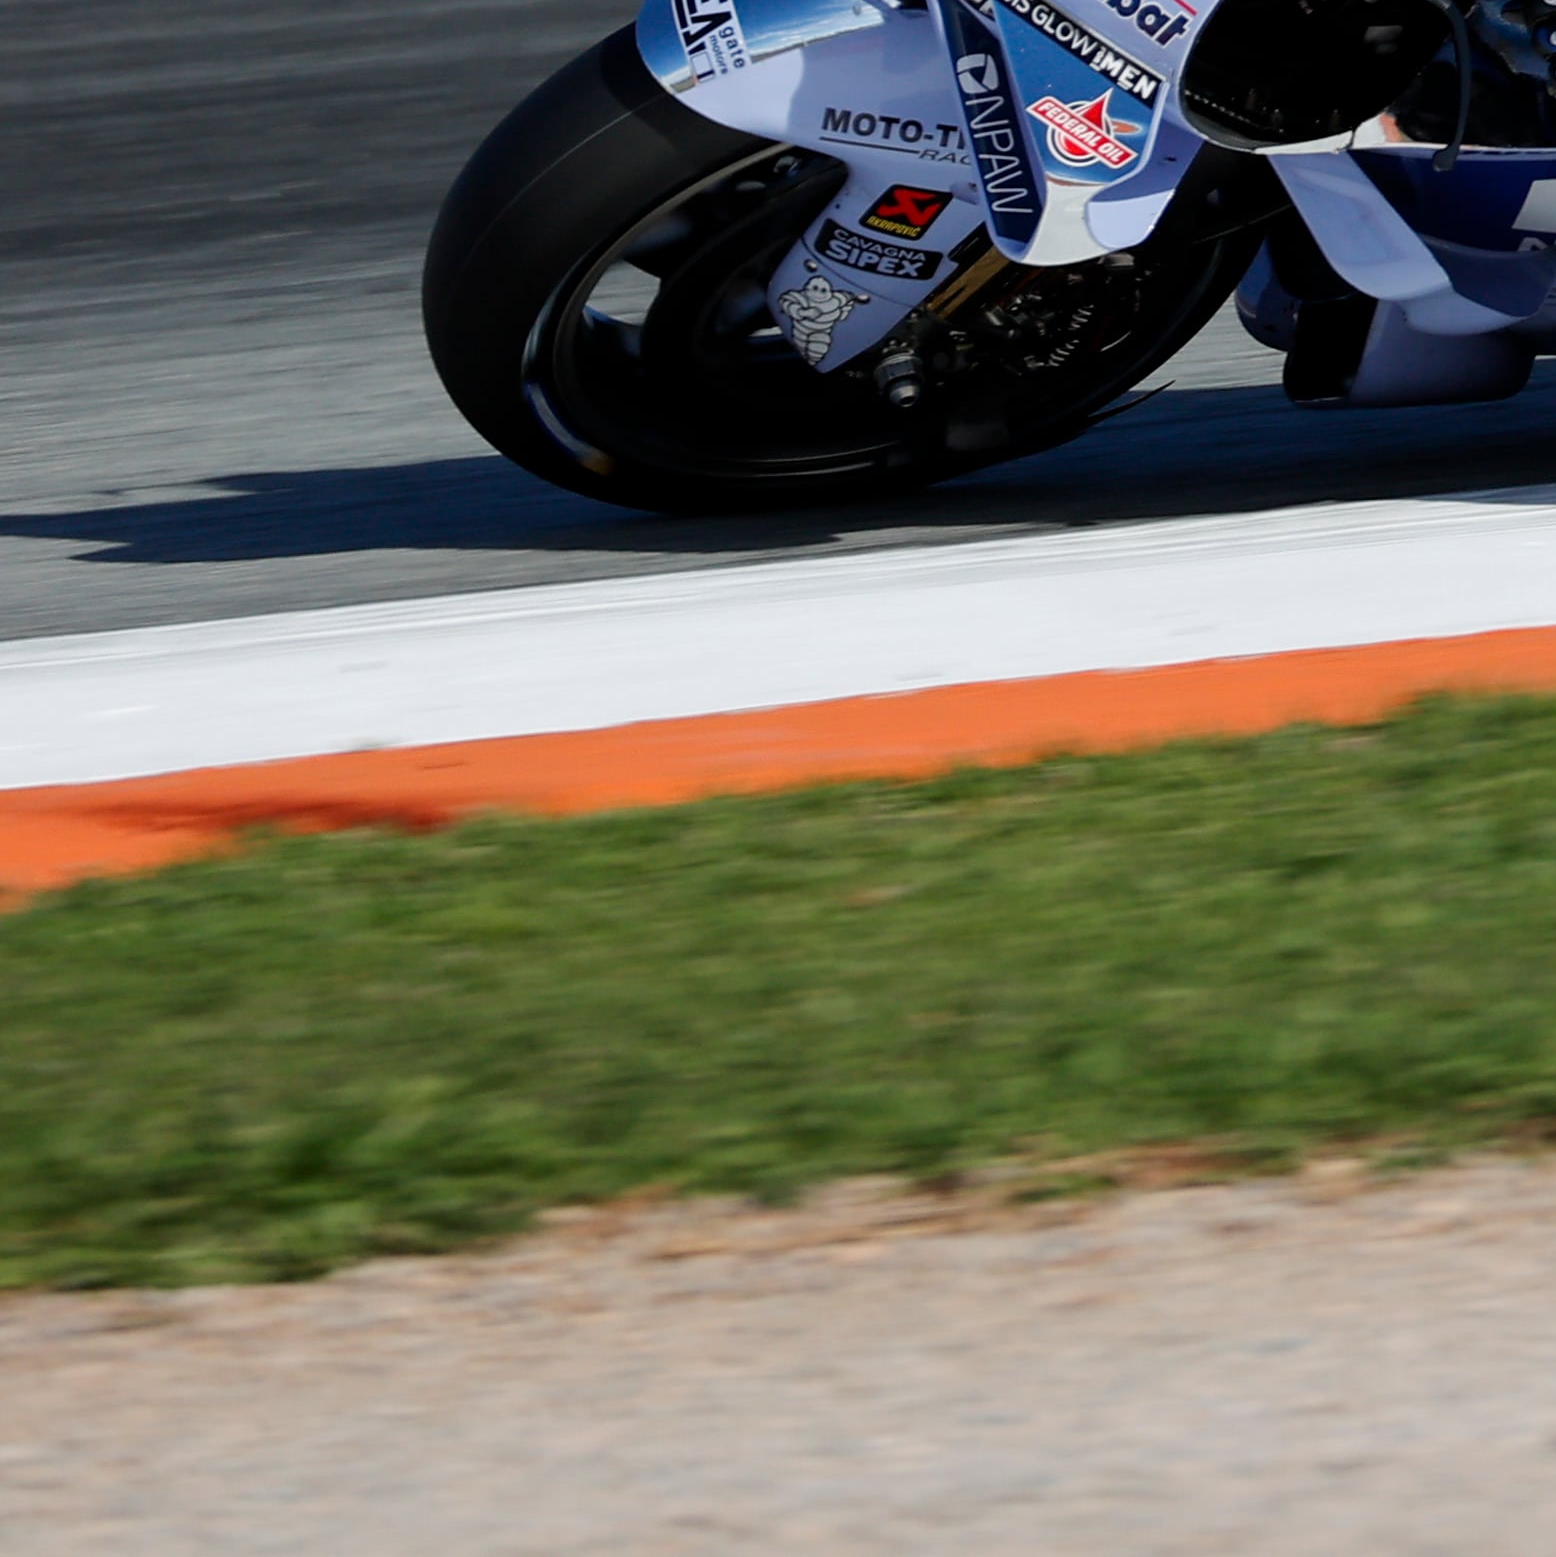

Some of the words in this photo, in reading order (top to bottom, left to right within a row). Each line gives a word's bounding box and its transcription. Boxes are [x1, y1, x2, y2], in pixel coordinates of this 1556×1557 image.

[718, 26, 746, 69] gate
[1031, 3, 1099, 57] GLOW
[708, 33, 730, 76] motors
[1037, 100, 1099, 147] FEDERAL
[1098, 139, 1125, 163] OIL
[965, 95, 1033, 214] NPAW
[825, 240, 925, 277] SIPEX
[833, 228, 927, 262] CAVAGNA
